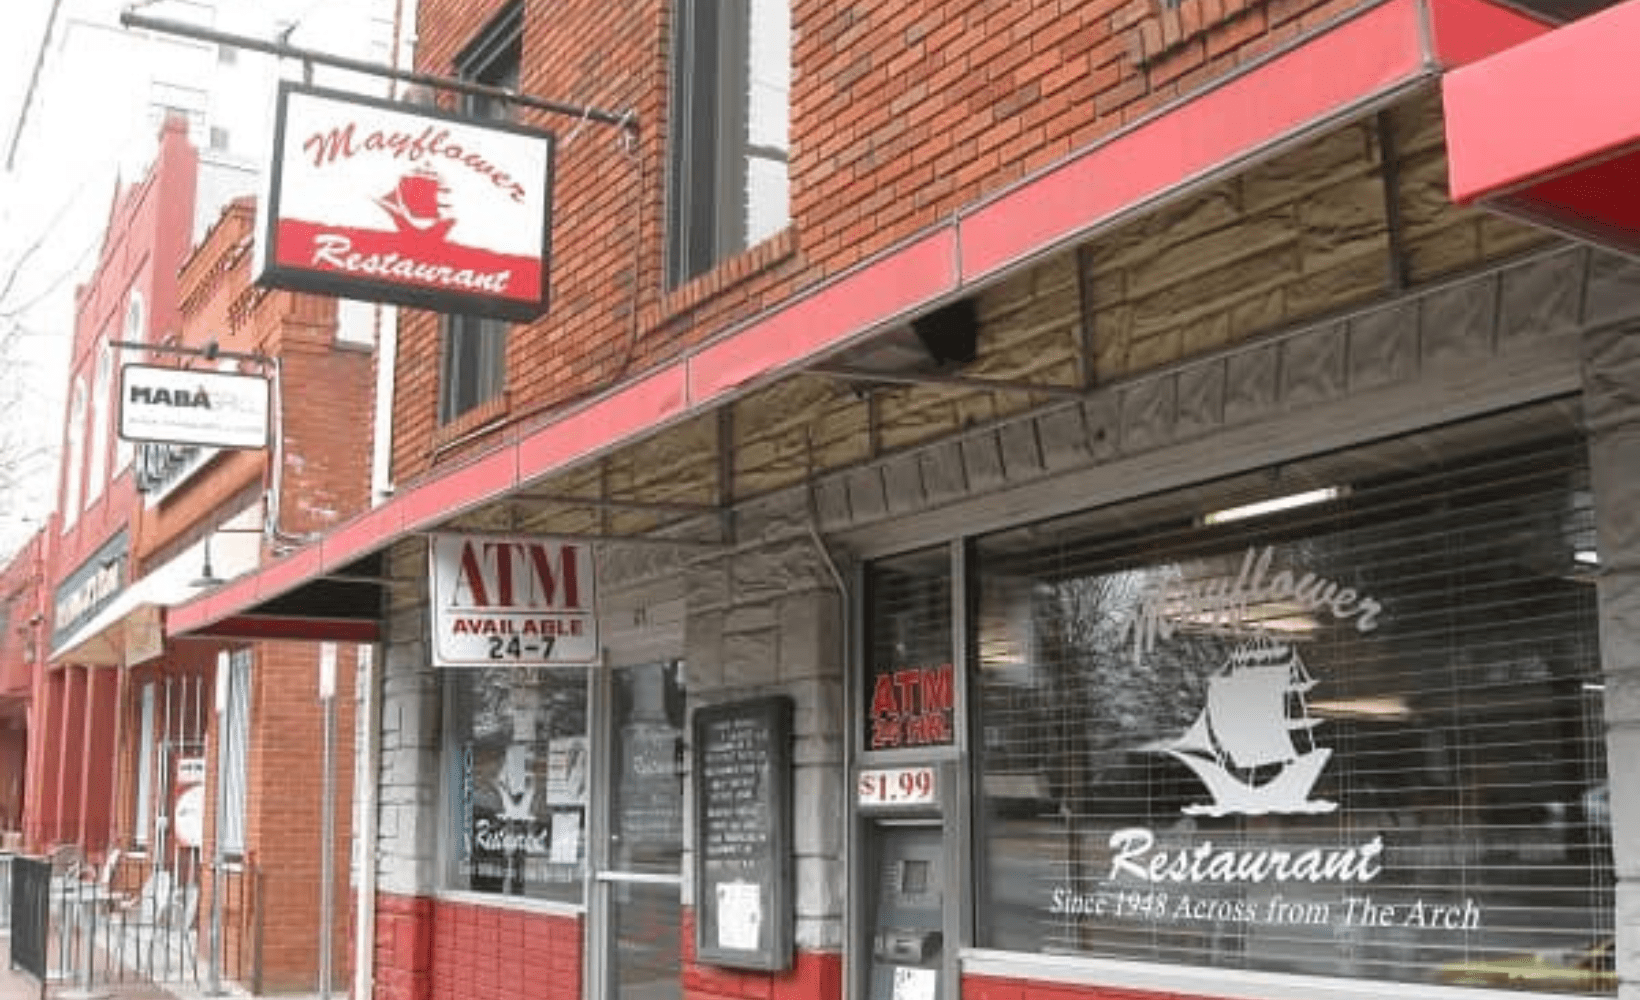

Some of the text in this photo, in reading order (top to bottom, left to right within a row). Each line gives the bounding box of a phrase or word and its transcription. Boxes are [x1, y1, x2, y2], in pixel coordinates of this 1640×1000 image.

[303, 121, 525, 205] Mayflower
[311, 233, 511, 294] Restaurant
[451, 539, 580, 608] ATM
[453, 619, 583, 637] AVAILABLE
[489, 635, 556, 660] 24-7
[870, 663, 955, 718] ATM
[858, 771, 931, 803] $1.99
[1108, 827, 1384, 883] Restaurant
[1050, 886, 1482, 930] Since 1948 Across from The Arch
